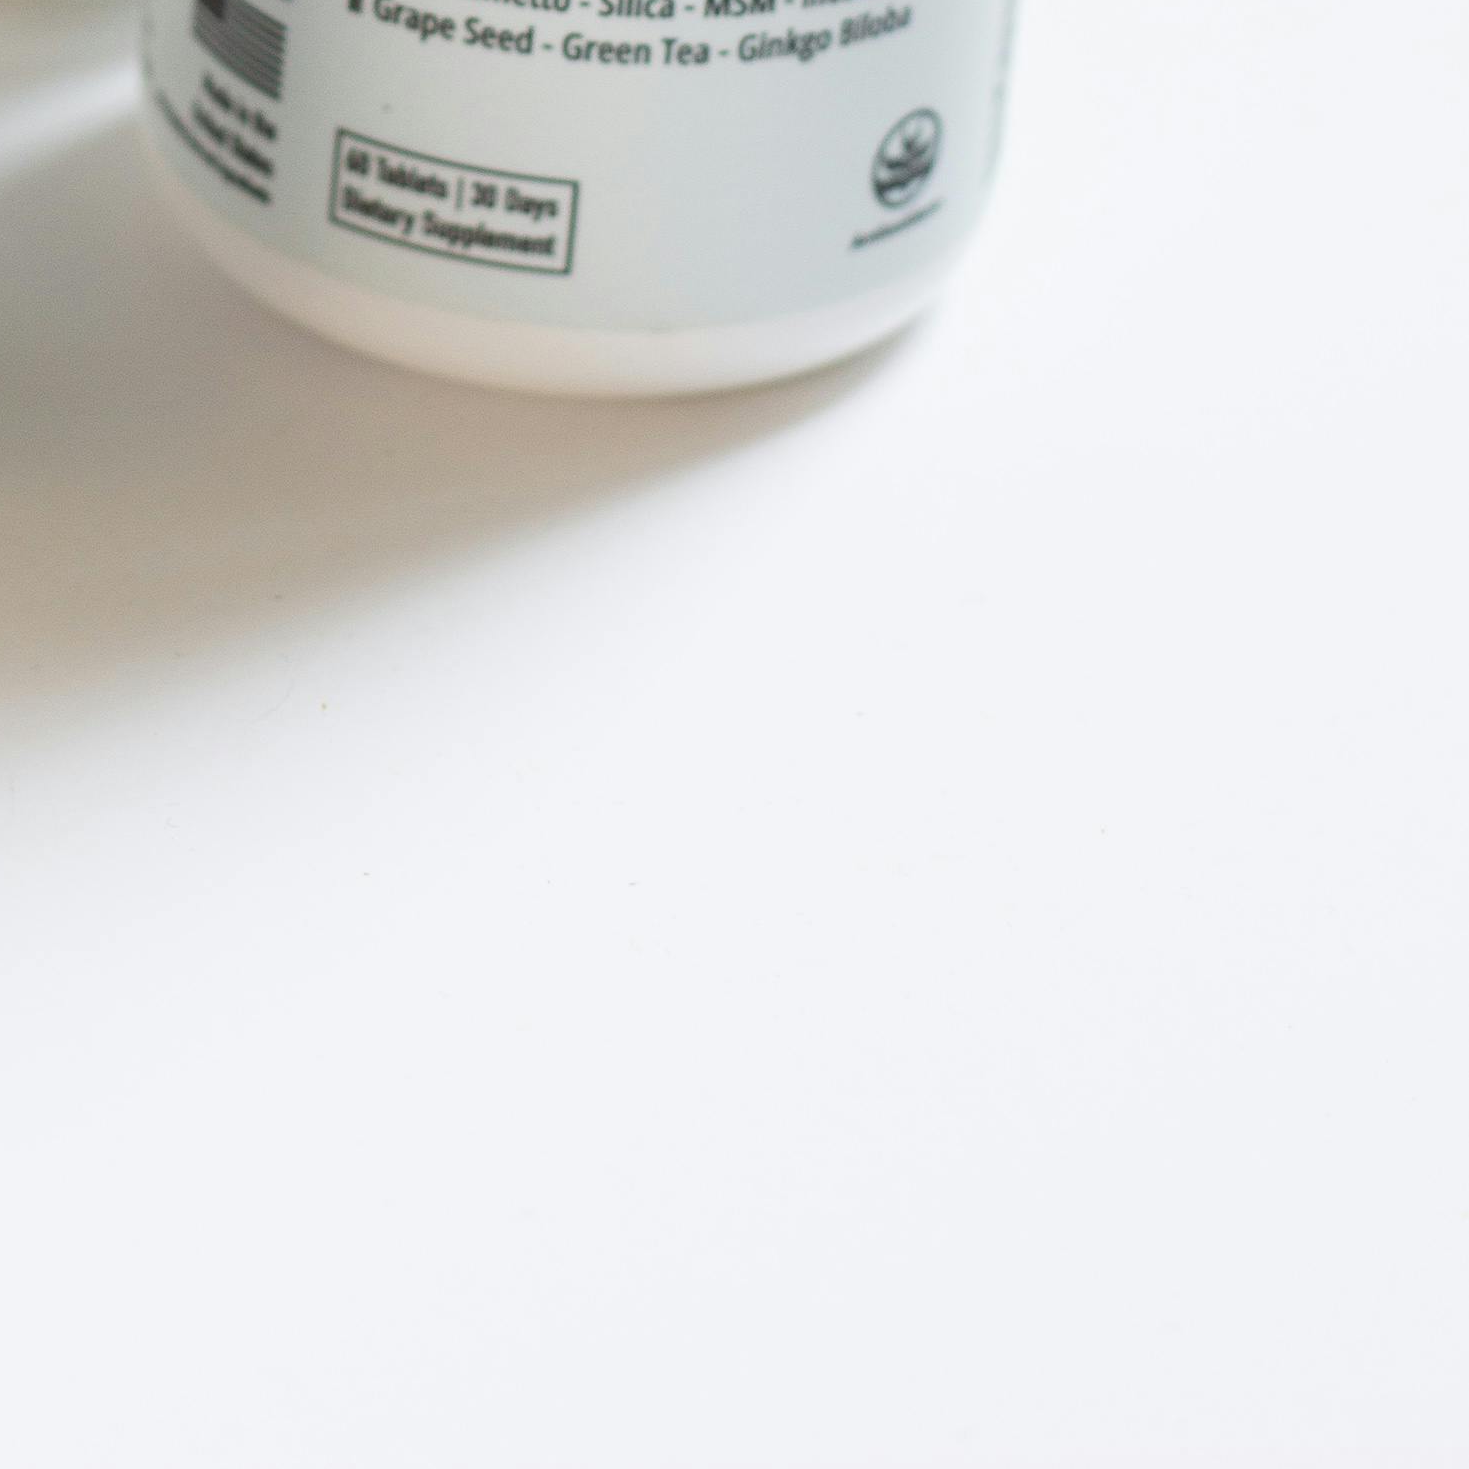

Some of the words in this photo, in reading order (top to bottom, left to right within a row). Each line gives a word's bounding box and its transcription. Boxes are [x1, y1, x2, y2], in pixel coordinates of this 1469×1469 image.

[463, 16, 535, 55] Seed
[561, 32, 653, 66] Green
[661, 35, 710, 66] Tea
[737, 15, 831, 64] Ginkgo
[837, 5, 913, 48] Biloba
